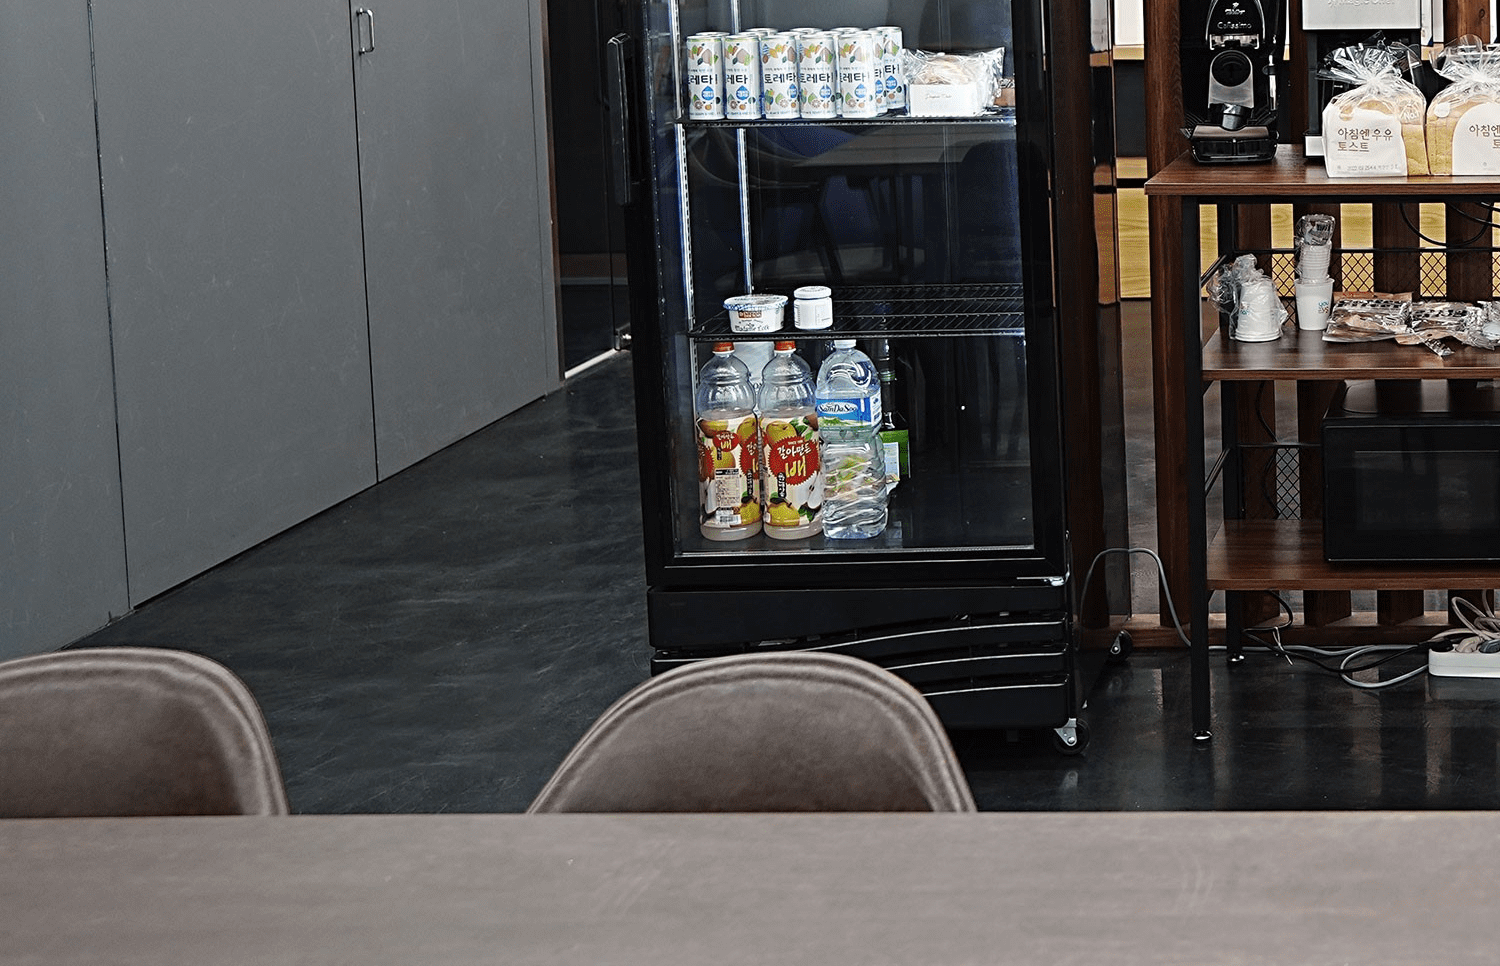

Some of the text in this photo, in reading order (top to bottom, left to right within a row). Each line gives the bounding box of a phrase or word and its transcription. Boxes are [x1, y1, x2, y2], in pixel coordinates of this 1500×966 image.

[1338, 128, 1393, 141] 아침엔 우유
[1469, 124, 1500, 137] 아침엔
[1338, 141, 1369, 152] 토스트
[777, 442, 812, 460] 갈아만든
[785, 455, 807, 477] 배
